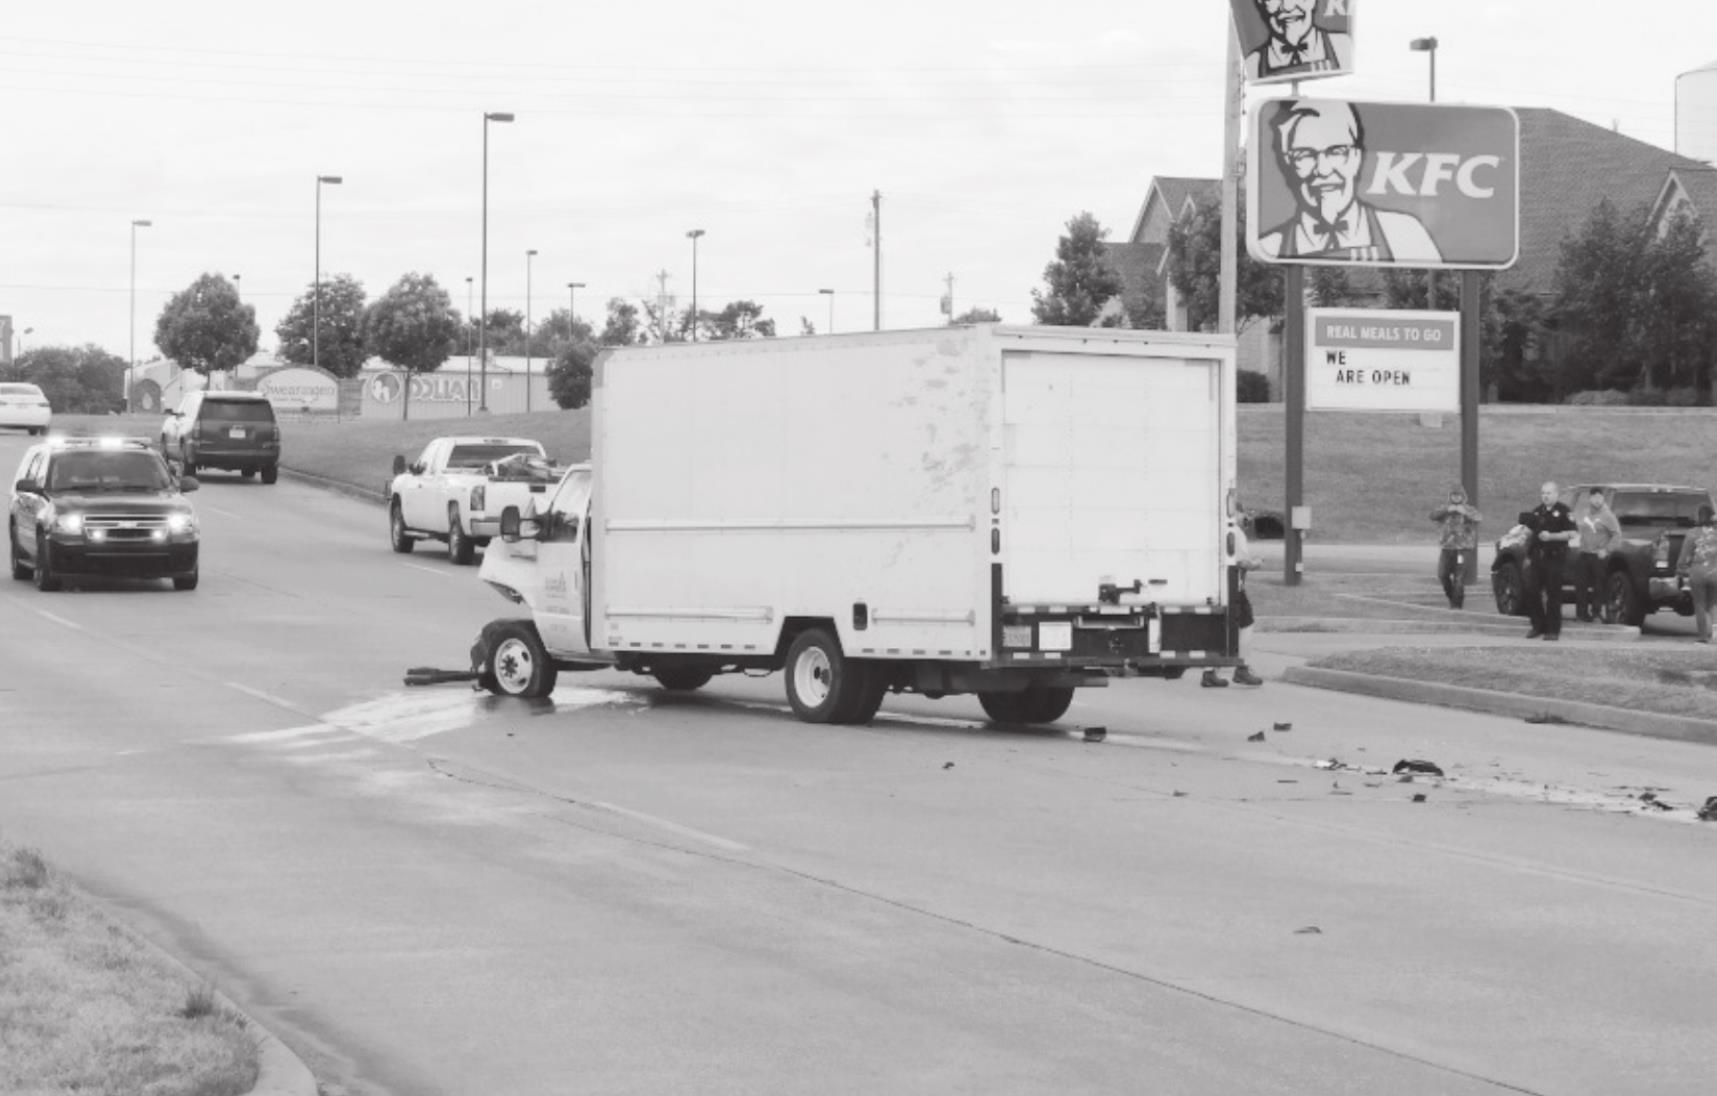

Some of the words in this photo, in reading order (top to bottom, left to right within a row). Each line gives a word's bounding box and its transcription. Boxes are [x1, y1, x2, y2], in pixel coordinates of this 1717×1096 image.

[1365, 151, 1500, 198] KFC
[1326, 325, 1357, 339] REAL
[1360, 326, 1400, 341] MEALS
[1403, 327, 1420, 341] TO
[1423, 328, 1442, 342] GO
[1326, 350, 1347, 365] WE
[1336, 370, 1365, 384] ARE
[1372, 370, 1411, 386] OPEN
